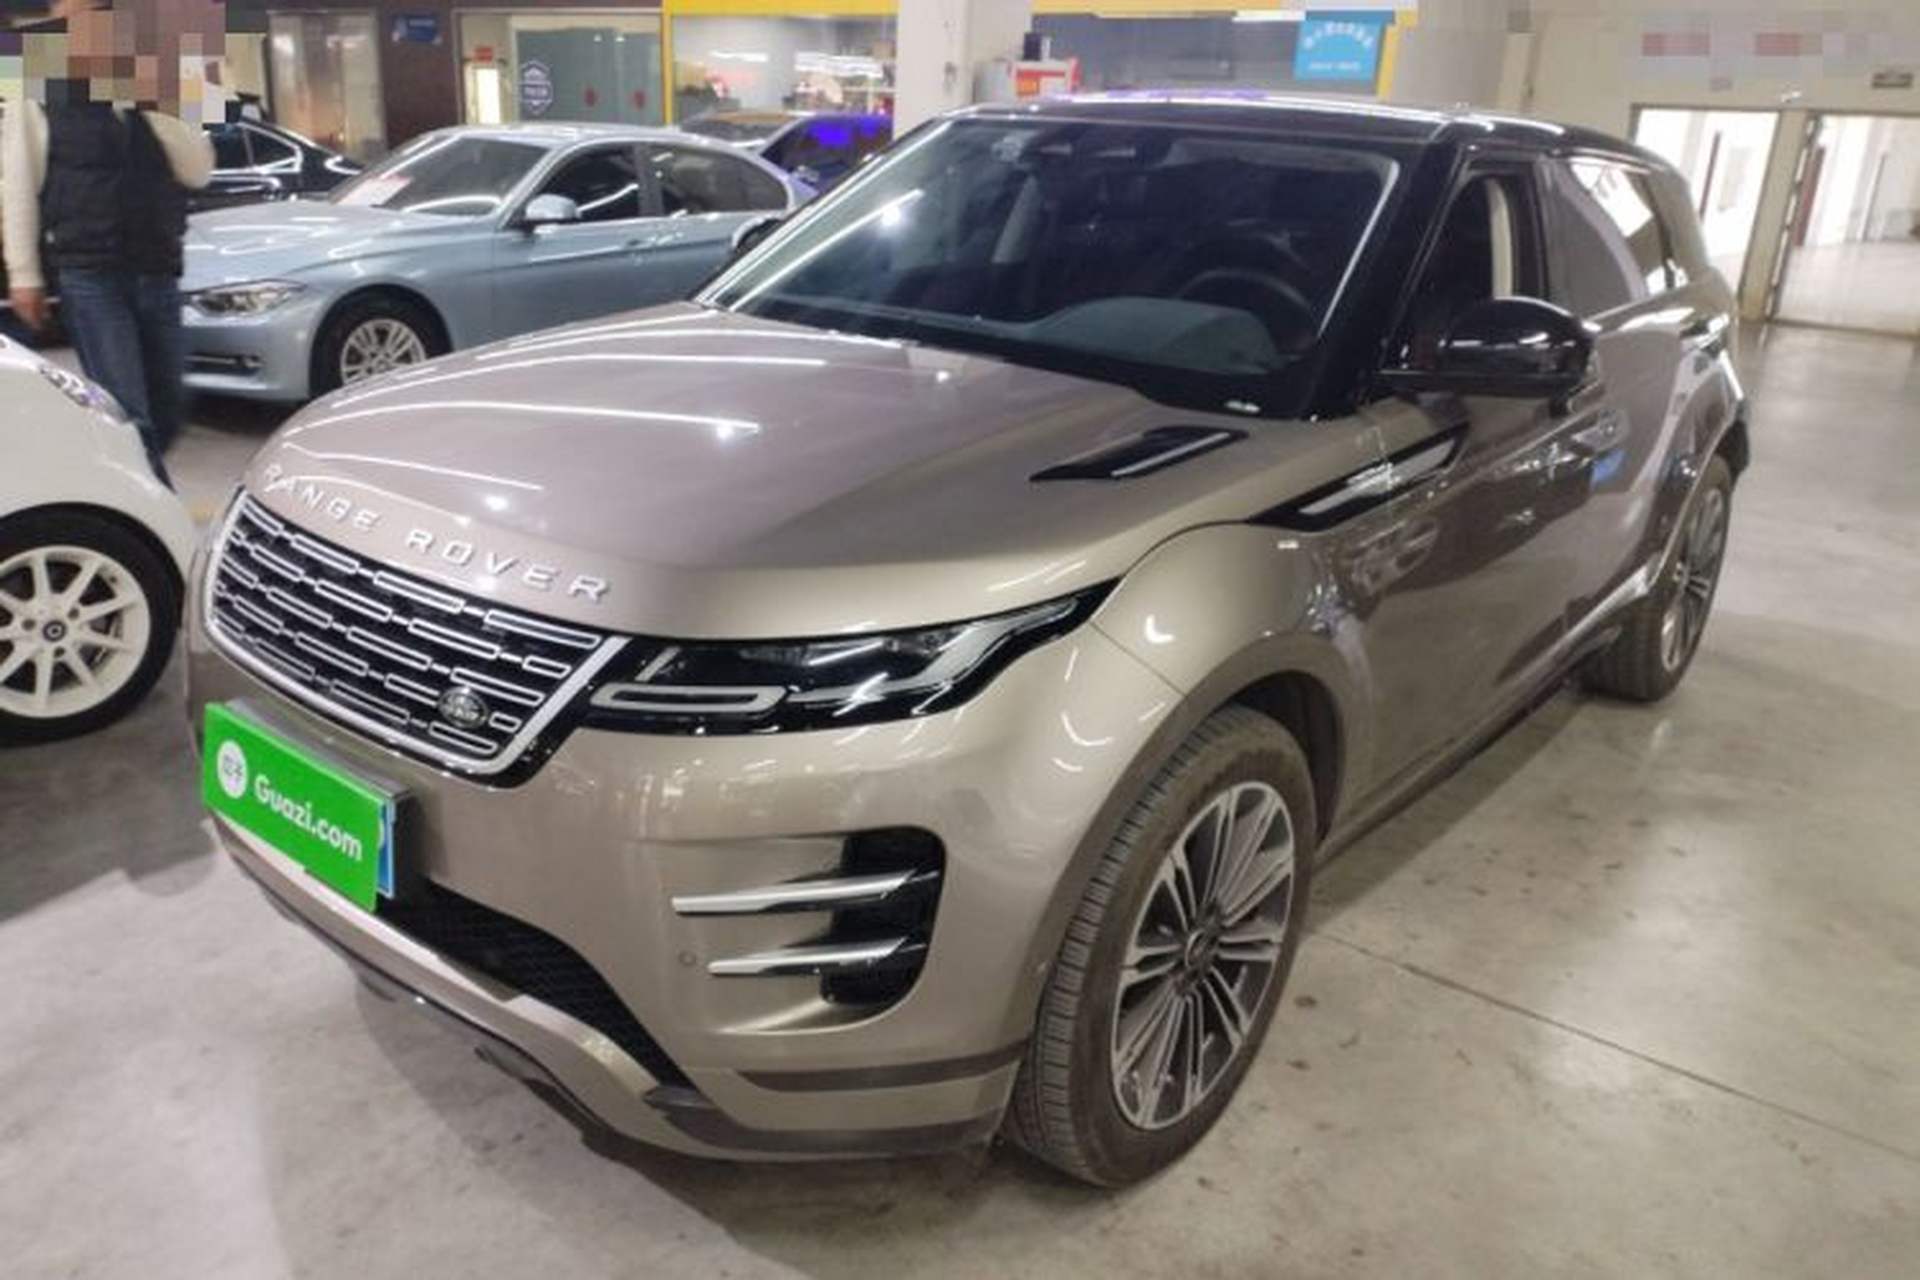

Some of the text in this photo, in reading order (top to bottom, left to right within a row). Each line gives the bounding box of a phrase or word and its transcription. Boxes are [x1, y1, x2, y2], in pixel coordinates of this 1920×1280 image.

[263, 463, 611, 603] RANGE ROVER
[254, 774, 363, 862] Guazi.com
